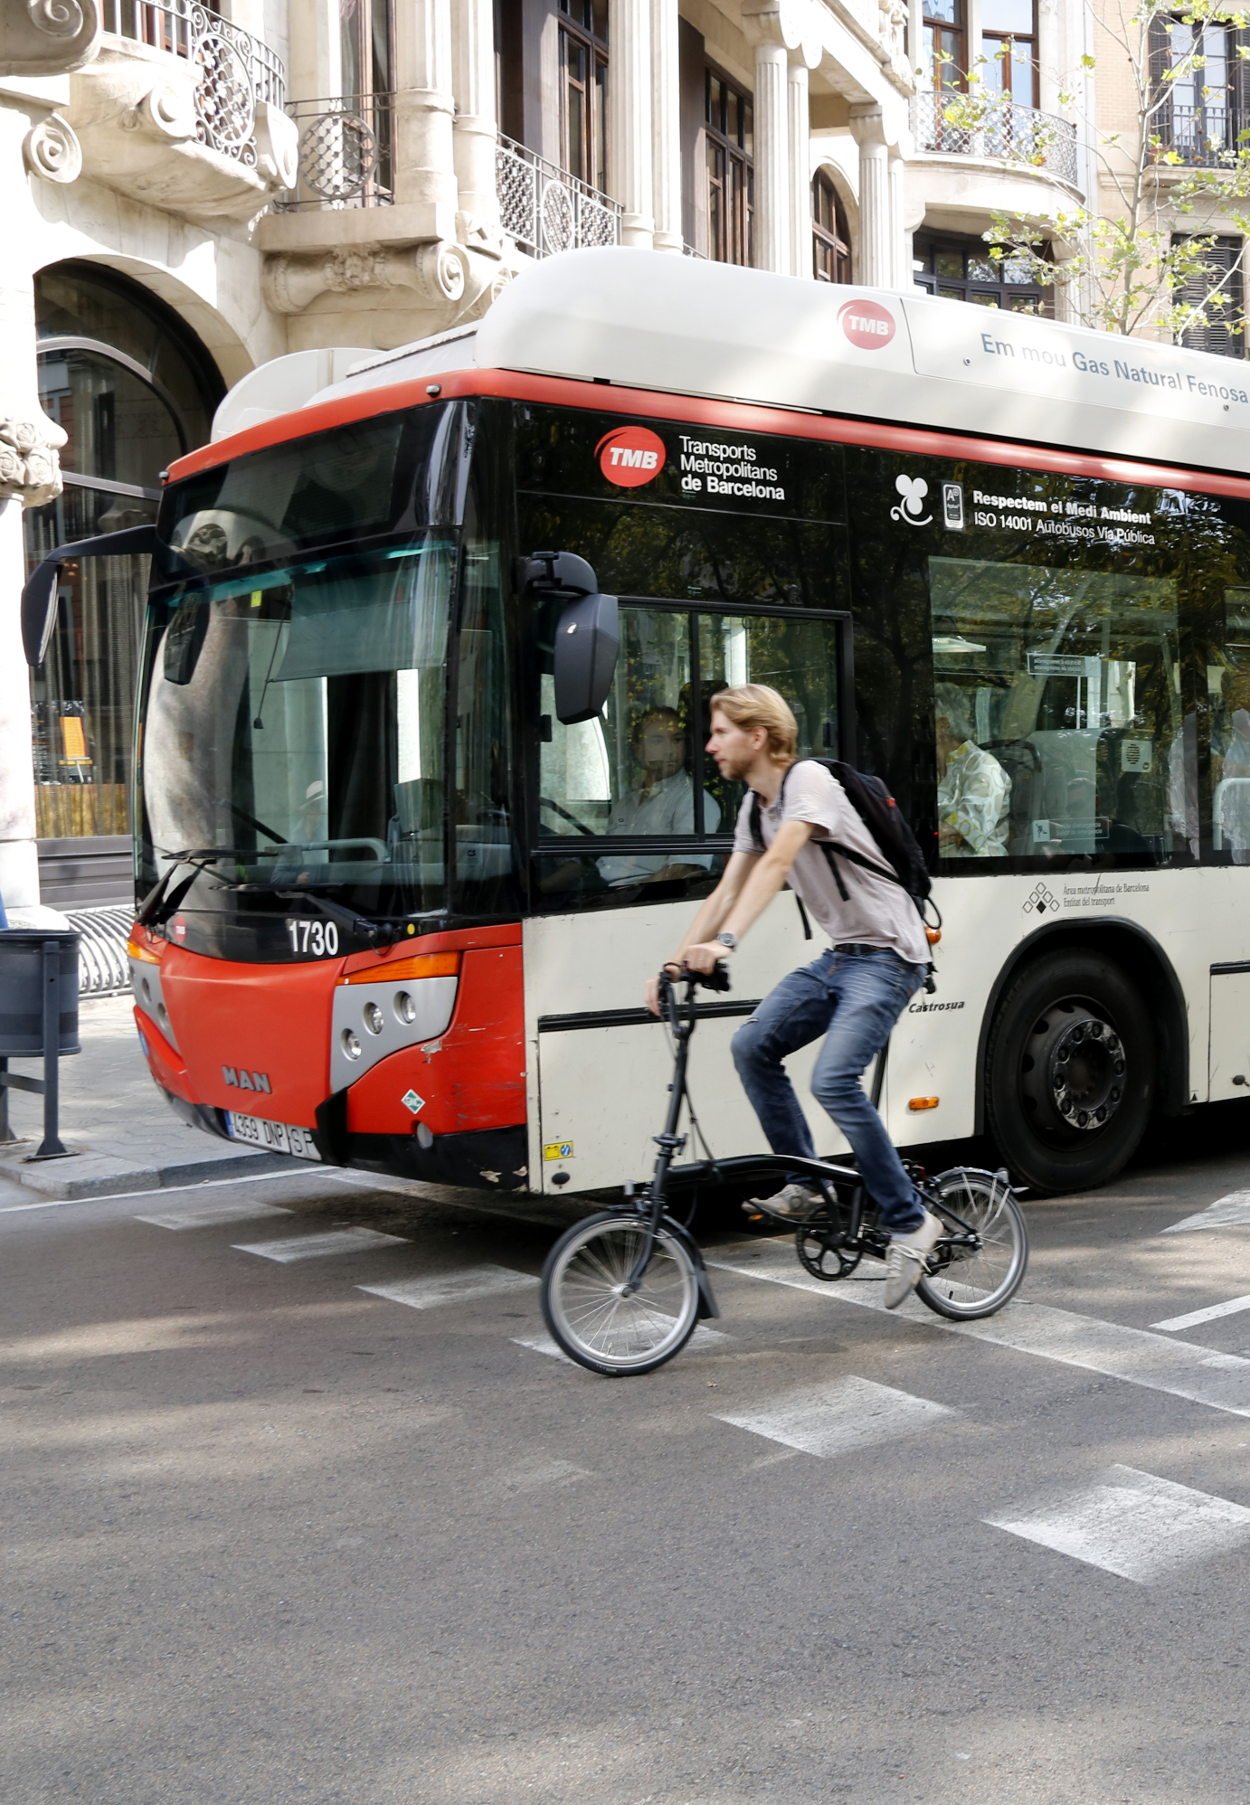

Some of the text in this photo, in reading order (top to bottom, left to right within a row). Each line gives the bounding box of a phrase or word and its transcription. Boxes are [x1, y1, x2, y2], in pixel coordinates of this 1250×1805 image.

[849, 315, 889, 336] TMB
[981, 333, 1014, 357] Em
[1022, 345, 1067, 368] mou
[1072, 351, 1110, 376] Gas
[1114, 360, 1182, 390] Natural
[1187, 376, 1249, 404] Fenosa
[609, 447, 659, 470] TMB
[679, 435, 757, 461] Transports
[680, 454, 778, 481] Metropolitans
[681, 474, 703, 491] de
[707, 476, 785, 500] Barcelona
[973, 490, 1048, 513] Respectem
[1051, 501, 1063, 514] el
[1066, 502, 1097, 518] Medi
[1101, 506, 1152, 525] Ambient
[974, 511, 997, 528] ISO
[1000, 514, 1032, 531] 14001
[1036, 519, 1096, 539] Autobusos
[1117, 528, 1155, 545] Pública
[1077, 885, 1114, 895] metropolitana
[1116, 884, 1122, 893] de
[1123, 883, 1150, 893] Barcelona
[1082, 897, 1090, 906] del
[1091, 897, 1115, 907] transport
[289, 920, 339, 956] 1730
[908, 1001, 965, 1013] Castrosua
[222, 1066, 272, 1094] MAN
